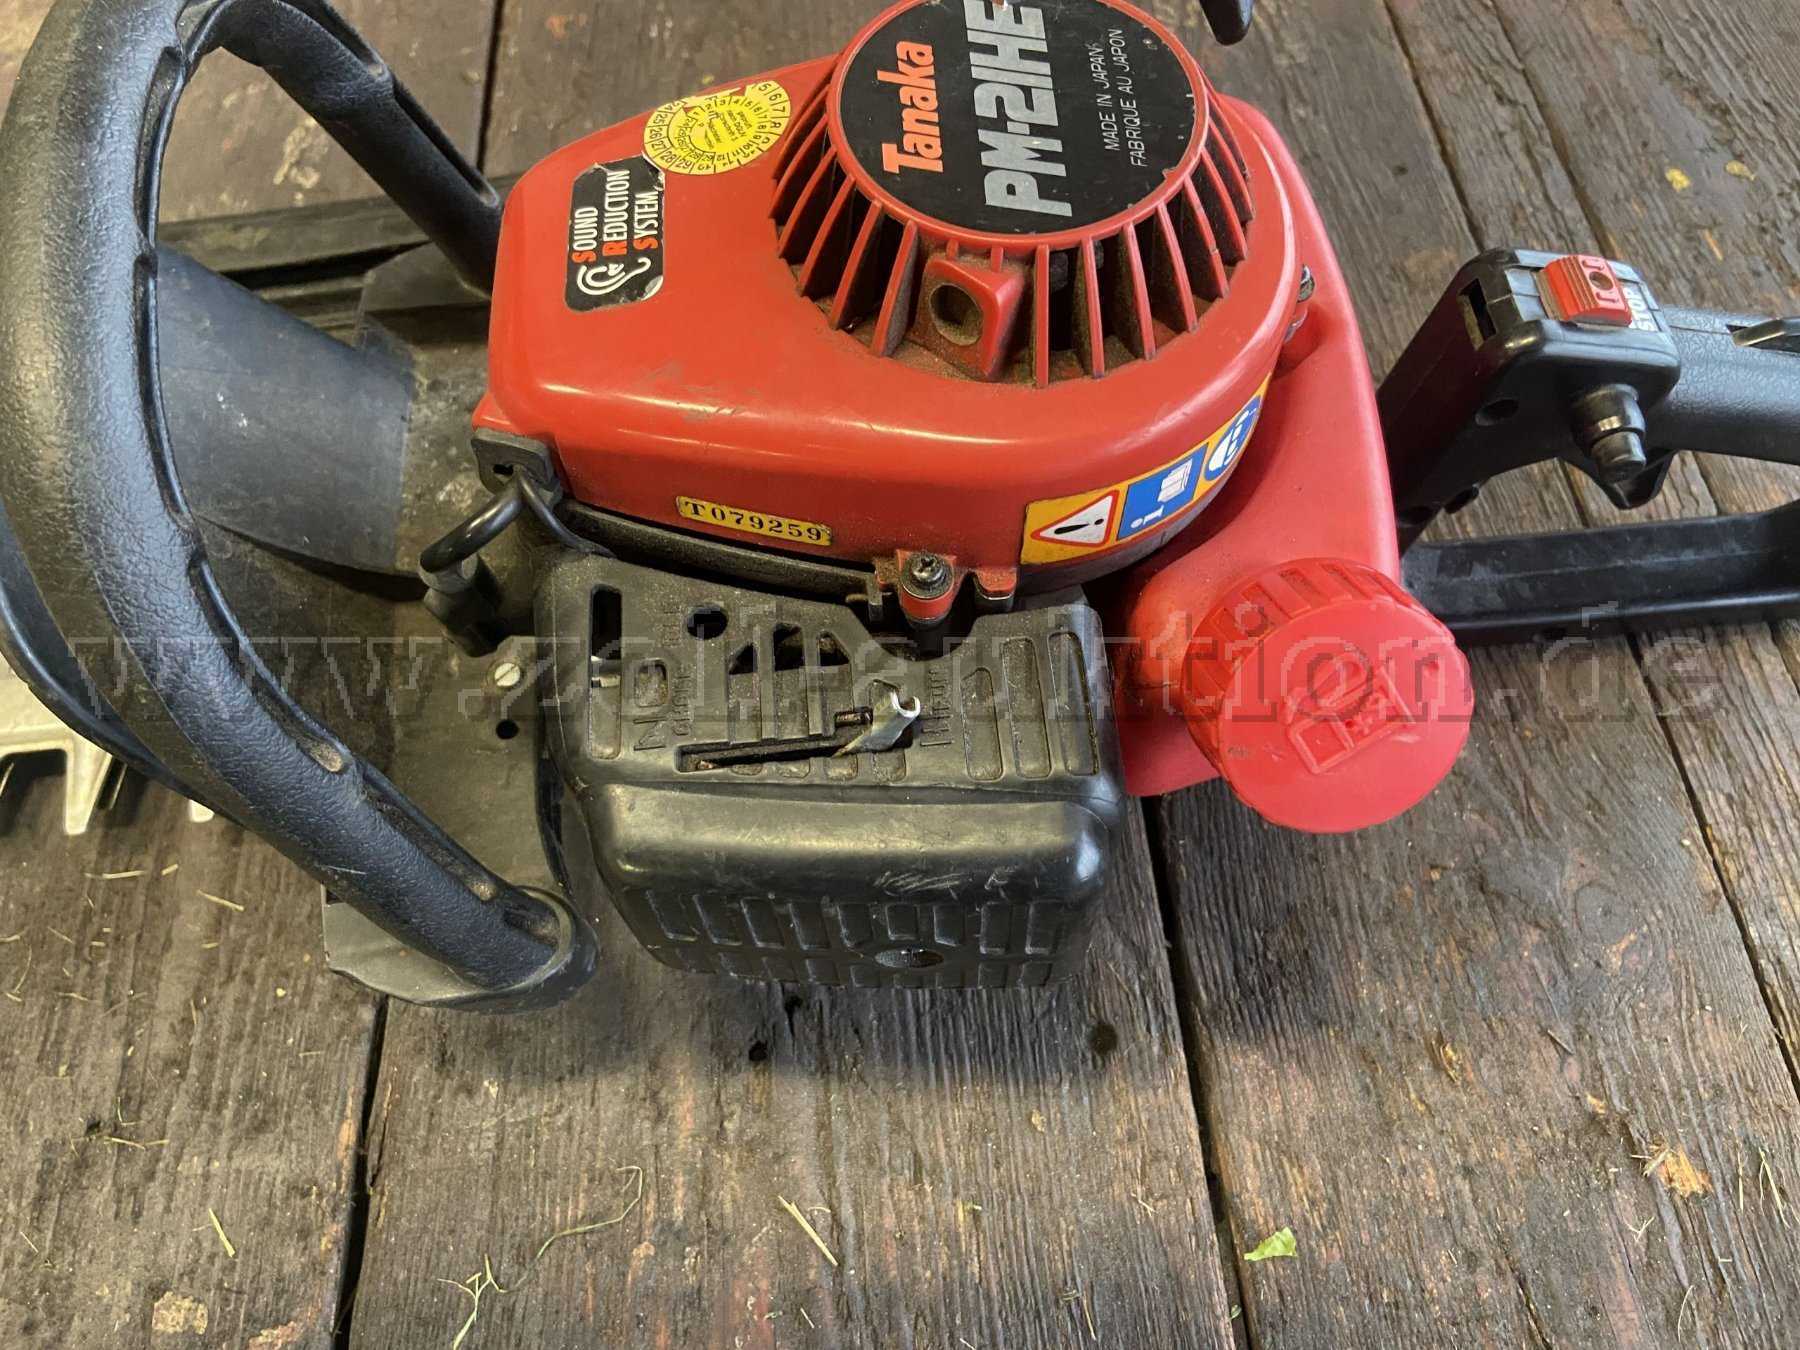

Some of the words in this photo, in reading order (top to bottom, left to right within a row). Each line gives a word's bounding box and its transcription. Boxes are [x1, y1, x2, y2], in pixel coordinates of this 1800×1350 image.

[1088, 46, 1111, 91] JAPAN
[1109, 28, 1131, 74] JAPON
[877, 40, 944, 174] Tanaka
[1096, 93, 1112, 107] IN
[1120, 76, 1133, 97] AU
[649, 127, 662, 140] 26
[652, 112, 667, 126] 25
[1100, 110, 1121, 152] MADE
[1120, 98, 1148, 168] FABRIQUE
[651, 140, 667, 153] 27
[659, 151, 677, 164] 28
[602, 170, 631, 257] REDUCTION
[633, 191, 659, 250] SYSTEM
[571, 206, 599, 264] SOUND
[685, 501, 822, 541] T079259
